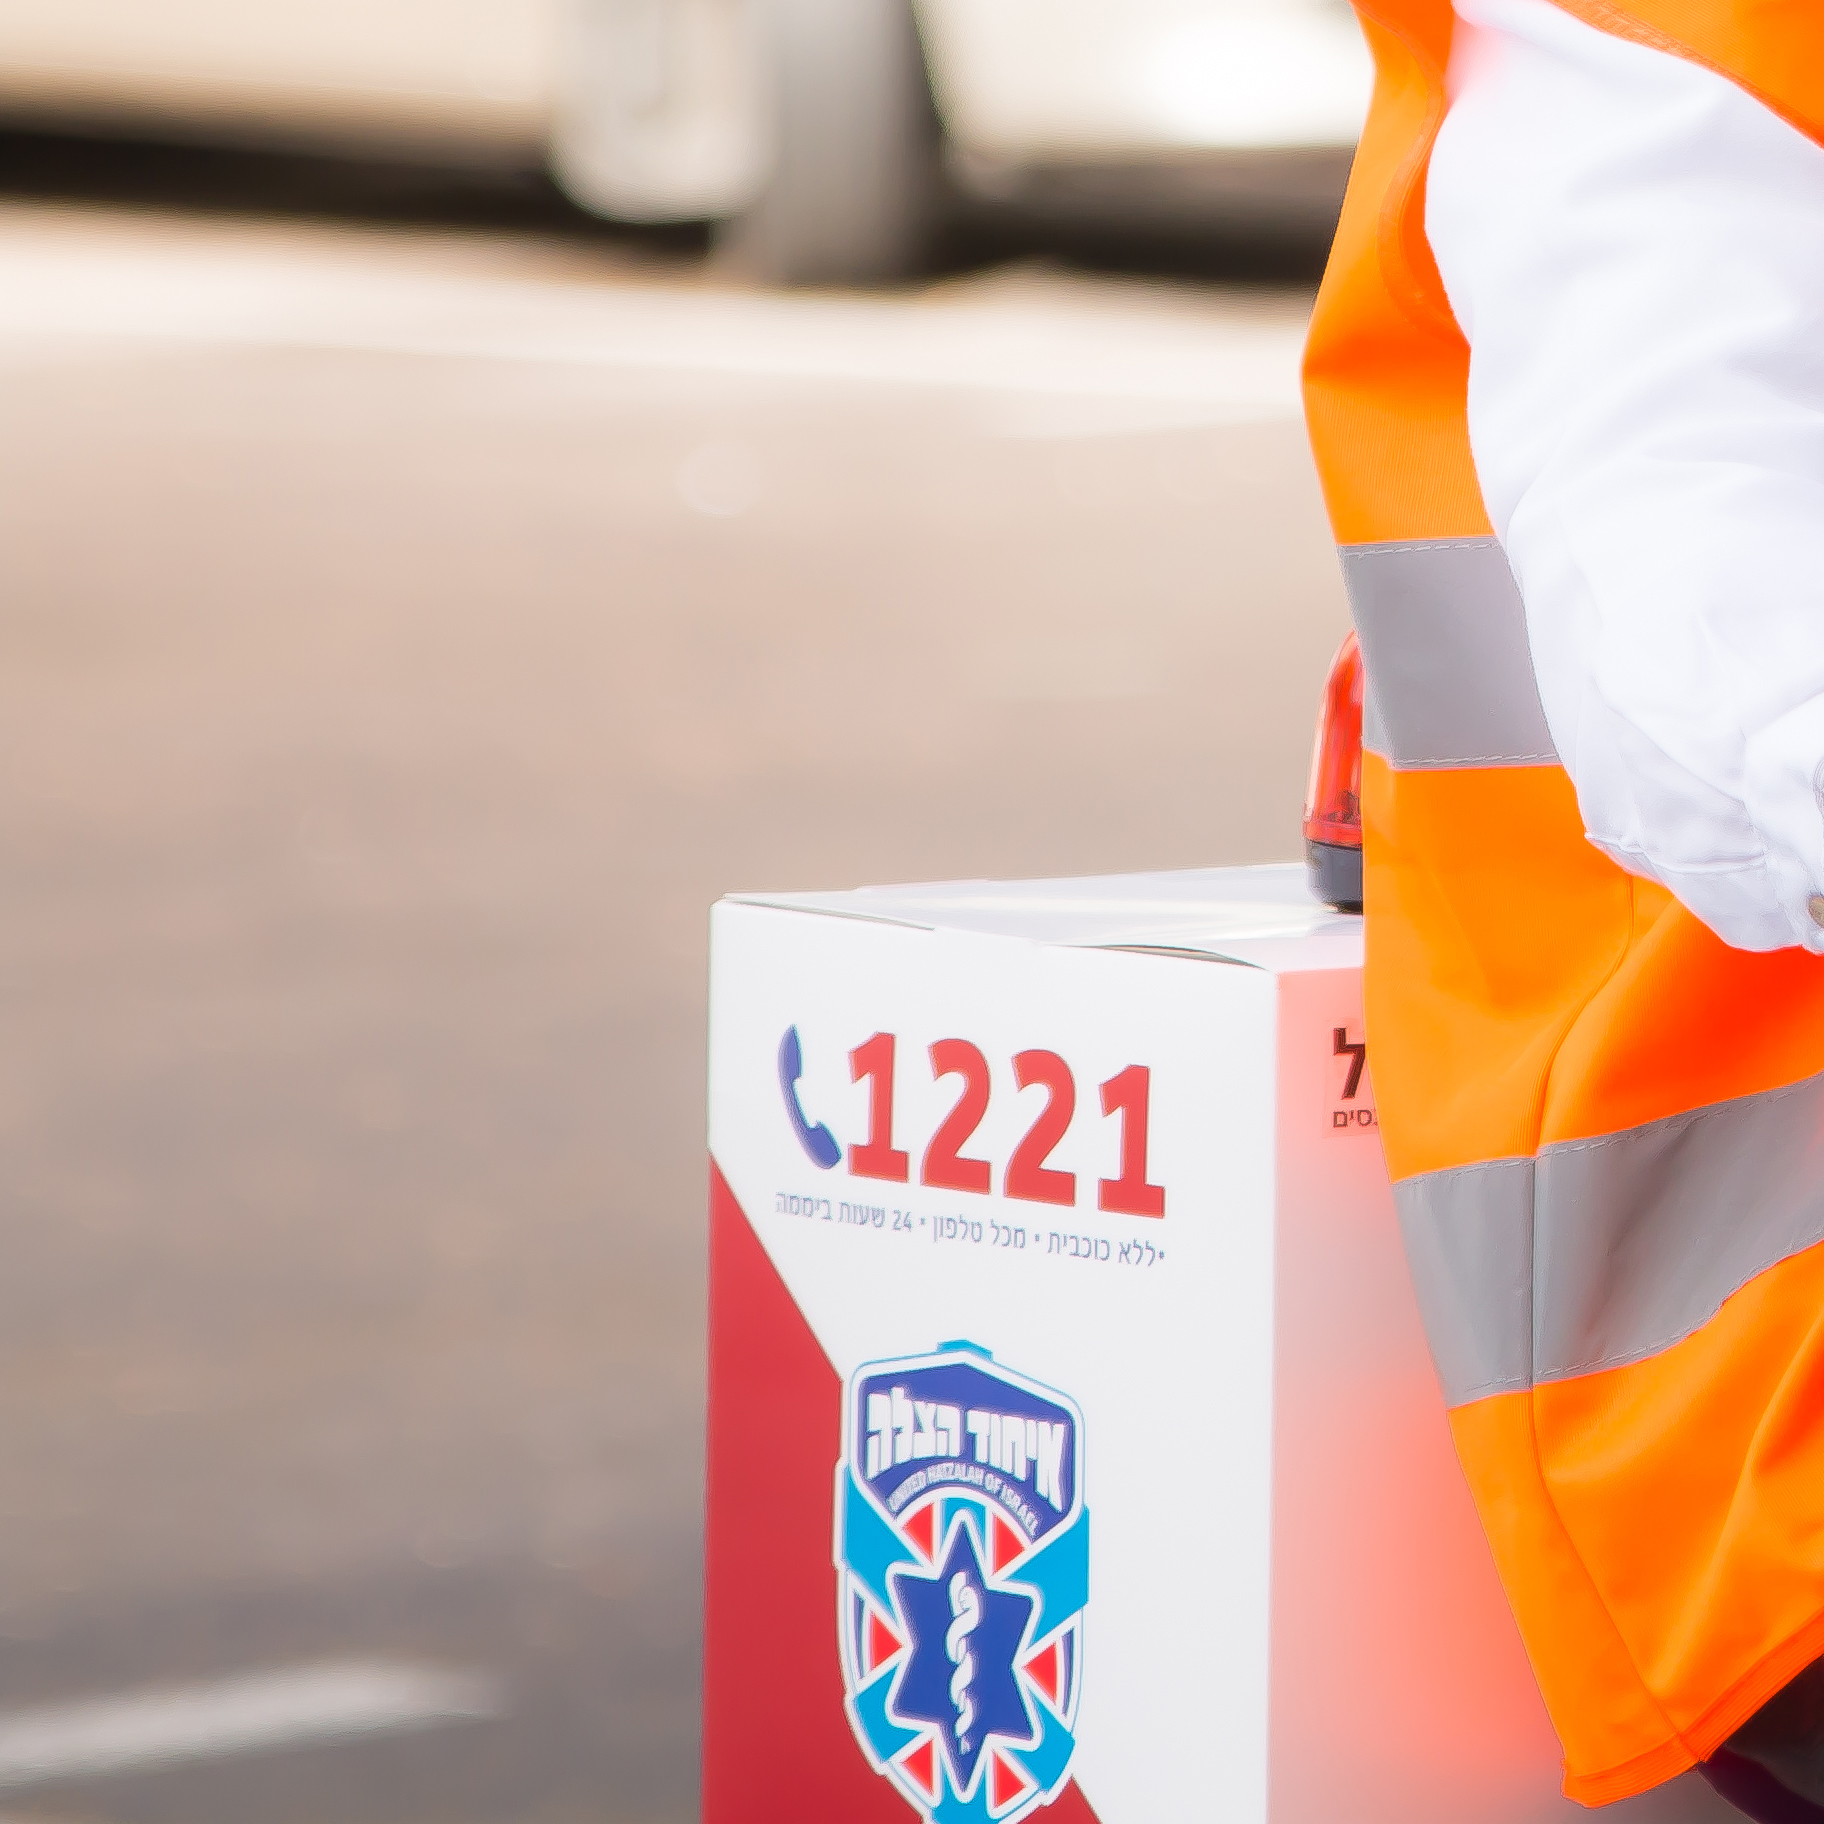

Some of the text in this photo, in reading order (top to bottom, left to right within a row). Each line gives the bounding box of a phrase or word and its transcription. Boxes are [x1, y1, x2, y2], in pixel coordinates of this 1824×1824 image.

[847, 1031, 1166, 1219] 1221
[838, 1200, 886, 1229] שעות
[891, 1208, 912, 1232] 24
[932, 1213, 984, 1244] טלפון
[990, 1218, 1027, 1249] מכל
[1047, 1230, 1111, 1262] כוכבית
[866, 1385, 1066, 1513] איחוד הצלה
